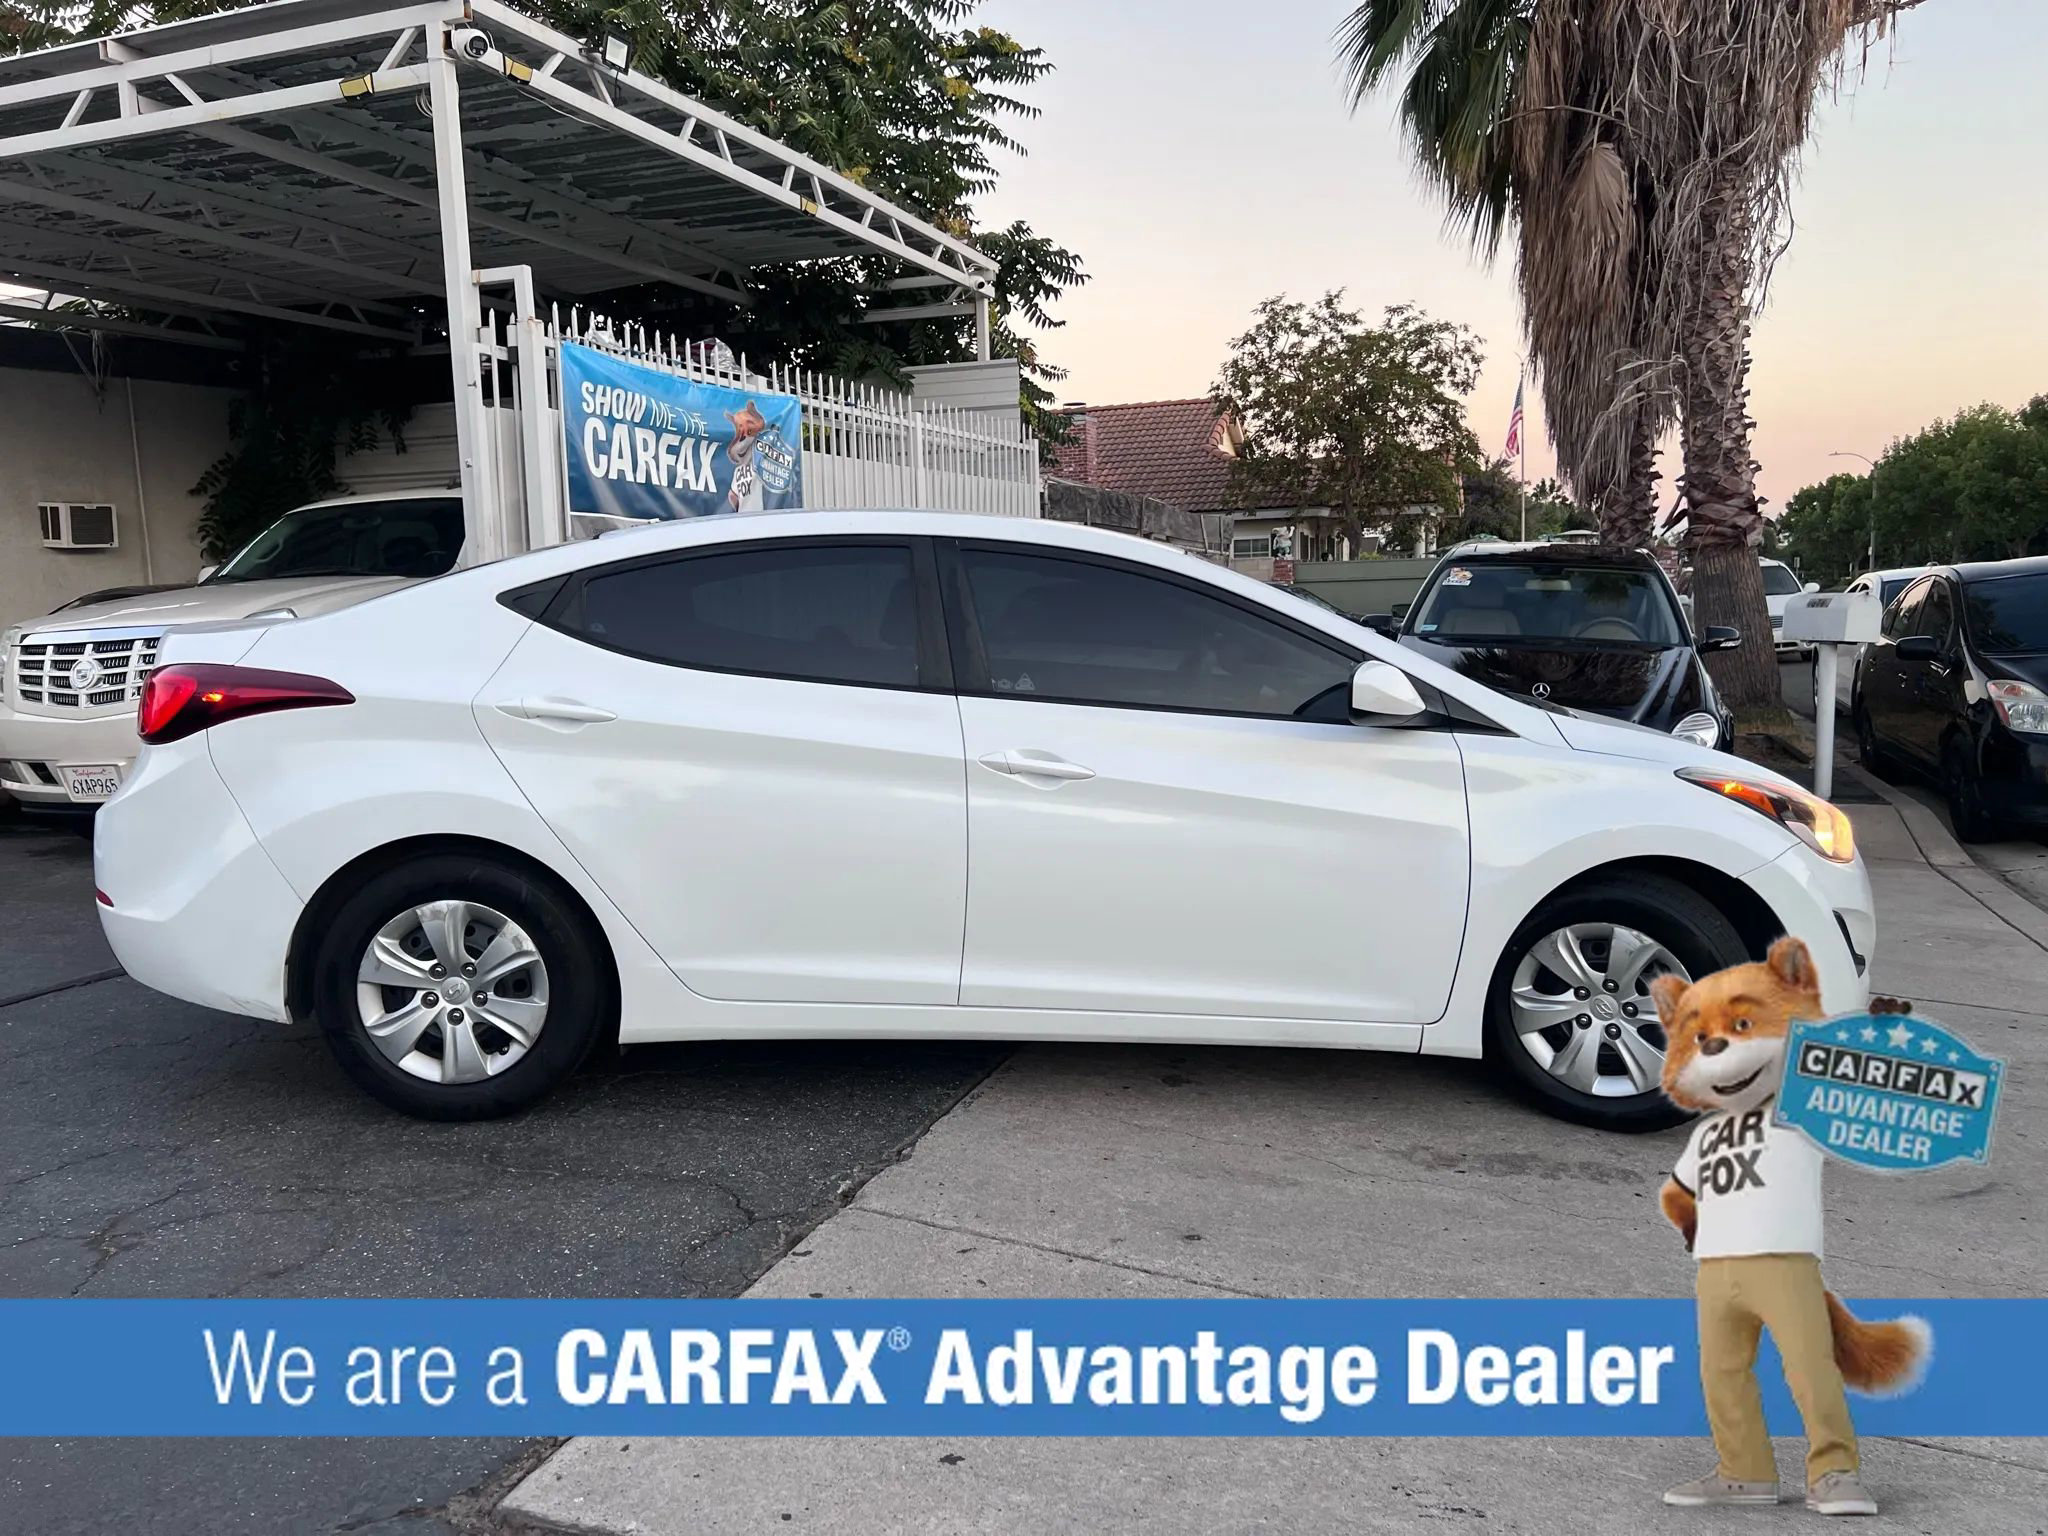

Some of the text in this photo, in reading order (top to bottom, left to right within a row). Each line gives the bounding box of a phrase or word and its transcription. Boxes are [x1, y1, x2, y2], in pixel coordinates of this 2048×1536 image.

[581, 381, 710, 438] SHOW ME THE
[583, 417, 719, 493] CARFAX
[736, 464, 753, 483] CAR
[736, 479, 753, 497] FOX
[72, 778, 119, 794] 6XAP965
